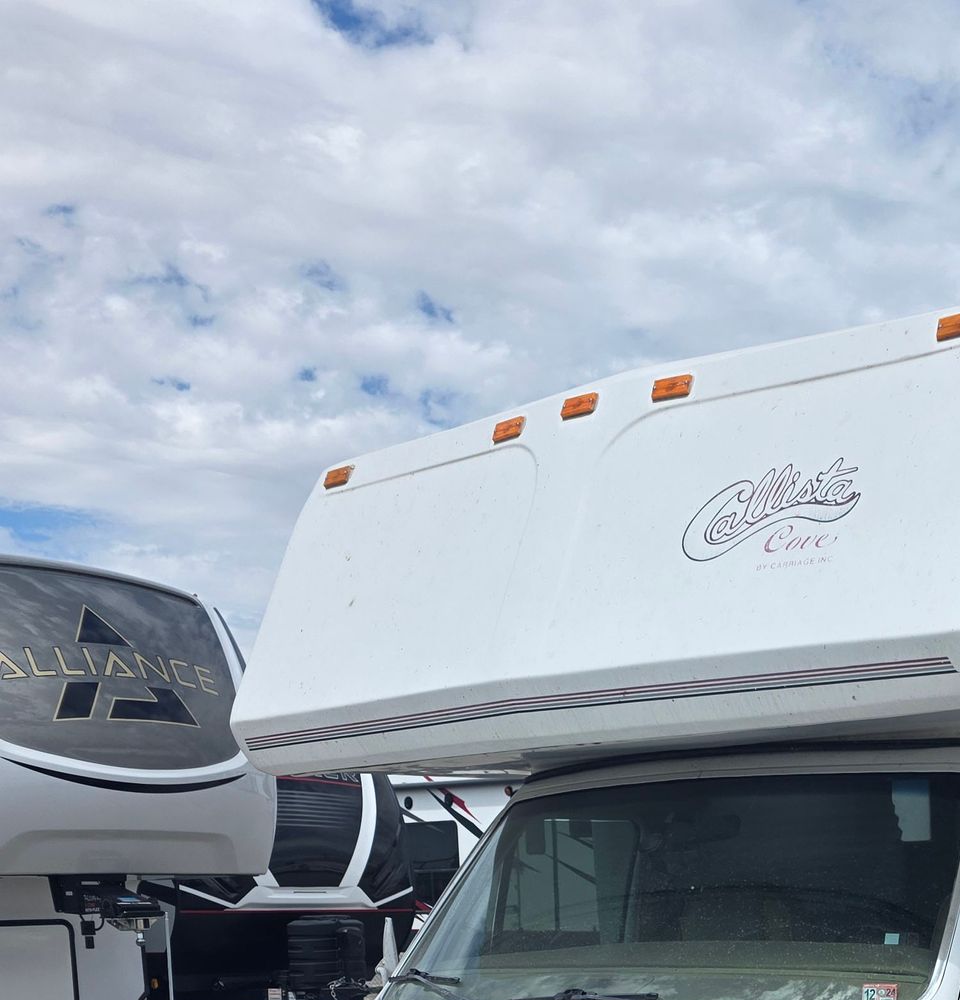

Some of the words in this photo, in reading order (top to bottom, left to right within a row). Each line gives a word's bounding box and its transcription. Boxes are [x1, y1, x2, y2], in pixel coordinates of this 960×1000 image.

[682, 457, 861, 561] Callista
[764, 525, 837, 553] Cove
[770, 557, 815, 570] CARRIAGE
[0, 647, 219, 696] ALLIANCE
[864, 988, 876, 1000] 12
[885, 988, 896, 997] 24
